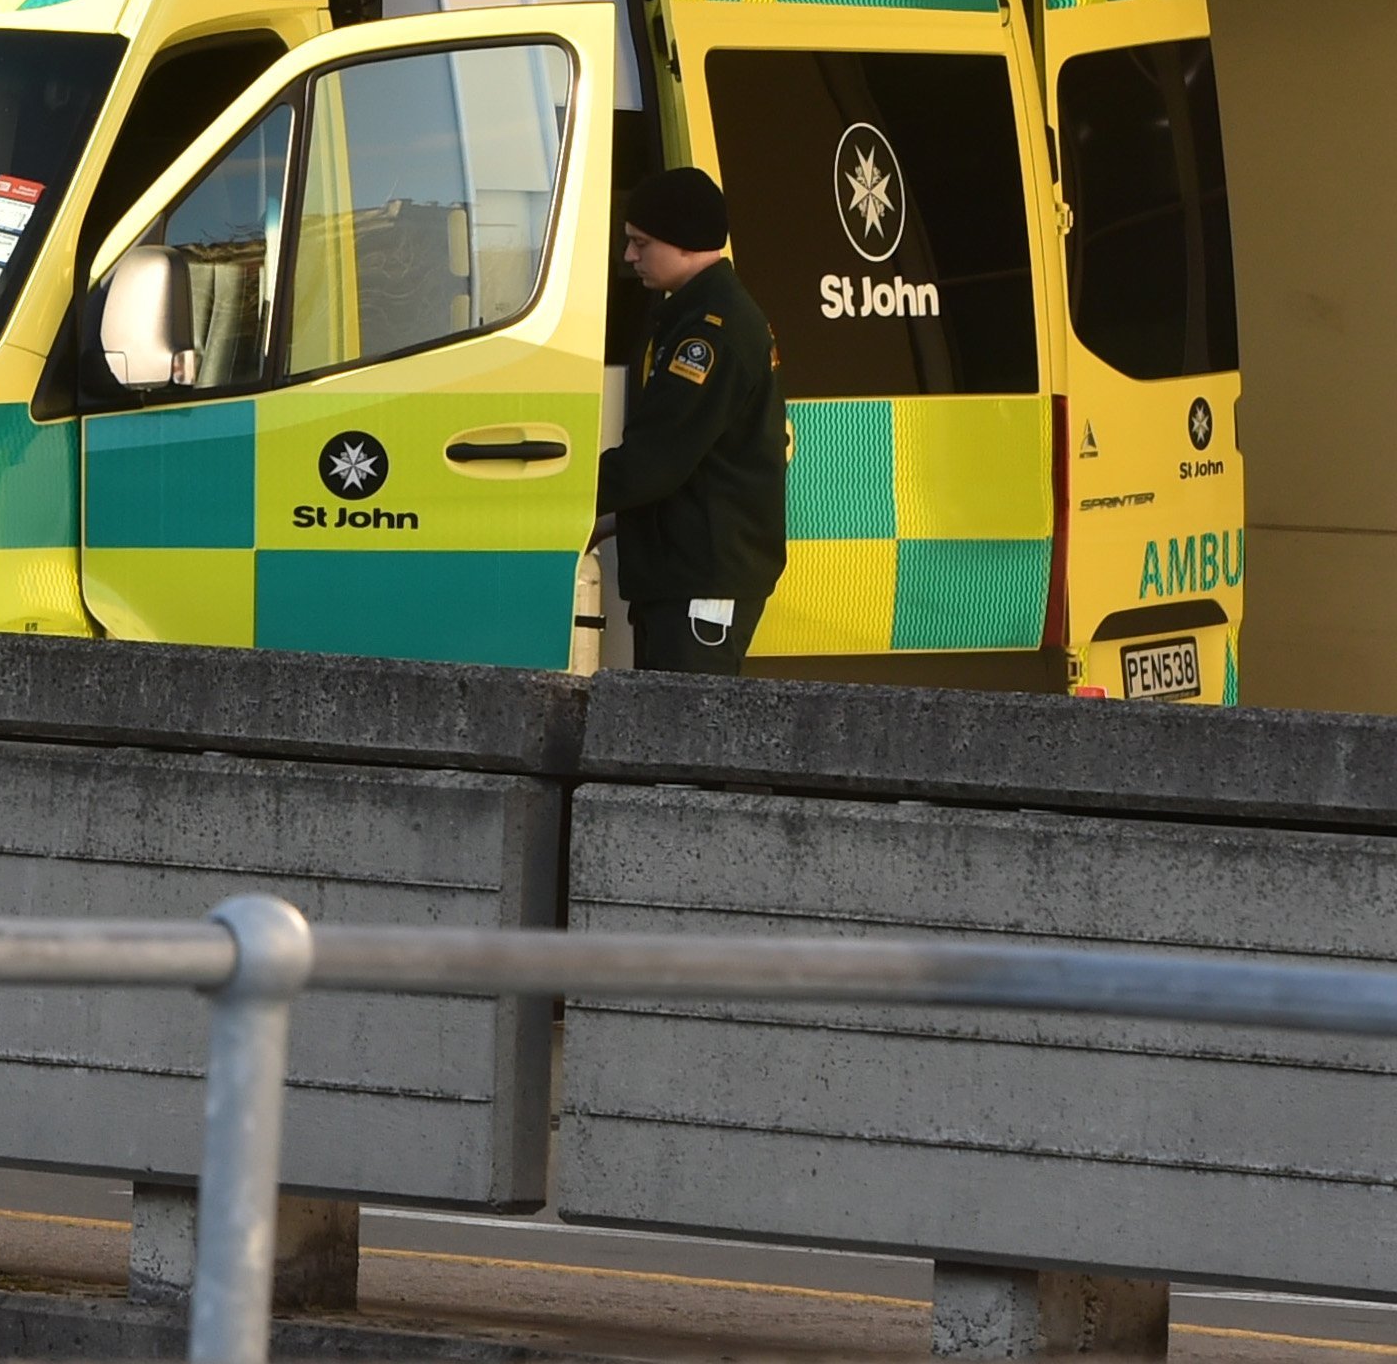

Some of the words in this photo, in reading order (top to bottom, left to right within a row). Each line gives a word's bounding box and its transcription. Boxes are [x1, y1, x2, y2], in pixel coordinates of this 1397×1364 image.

[820, 274, 855, 319] St
[860, 275, 940, 317] John
[1179, 462, 1192, 479] St
[1194, 460, 1224, 477] John
[292, 505, 327, 528] St
[334, 507, 418, 529] John
[1079, 492, 1155, 512] SPRINTER
[1139, 528, 1244, 600] AMBU
[1127, 650, 1195, 694] PEN538
